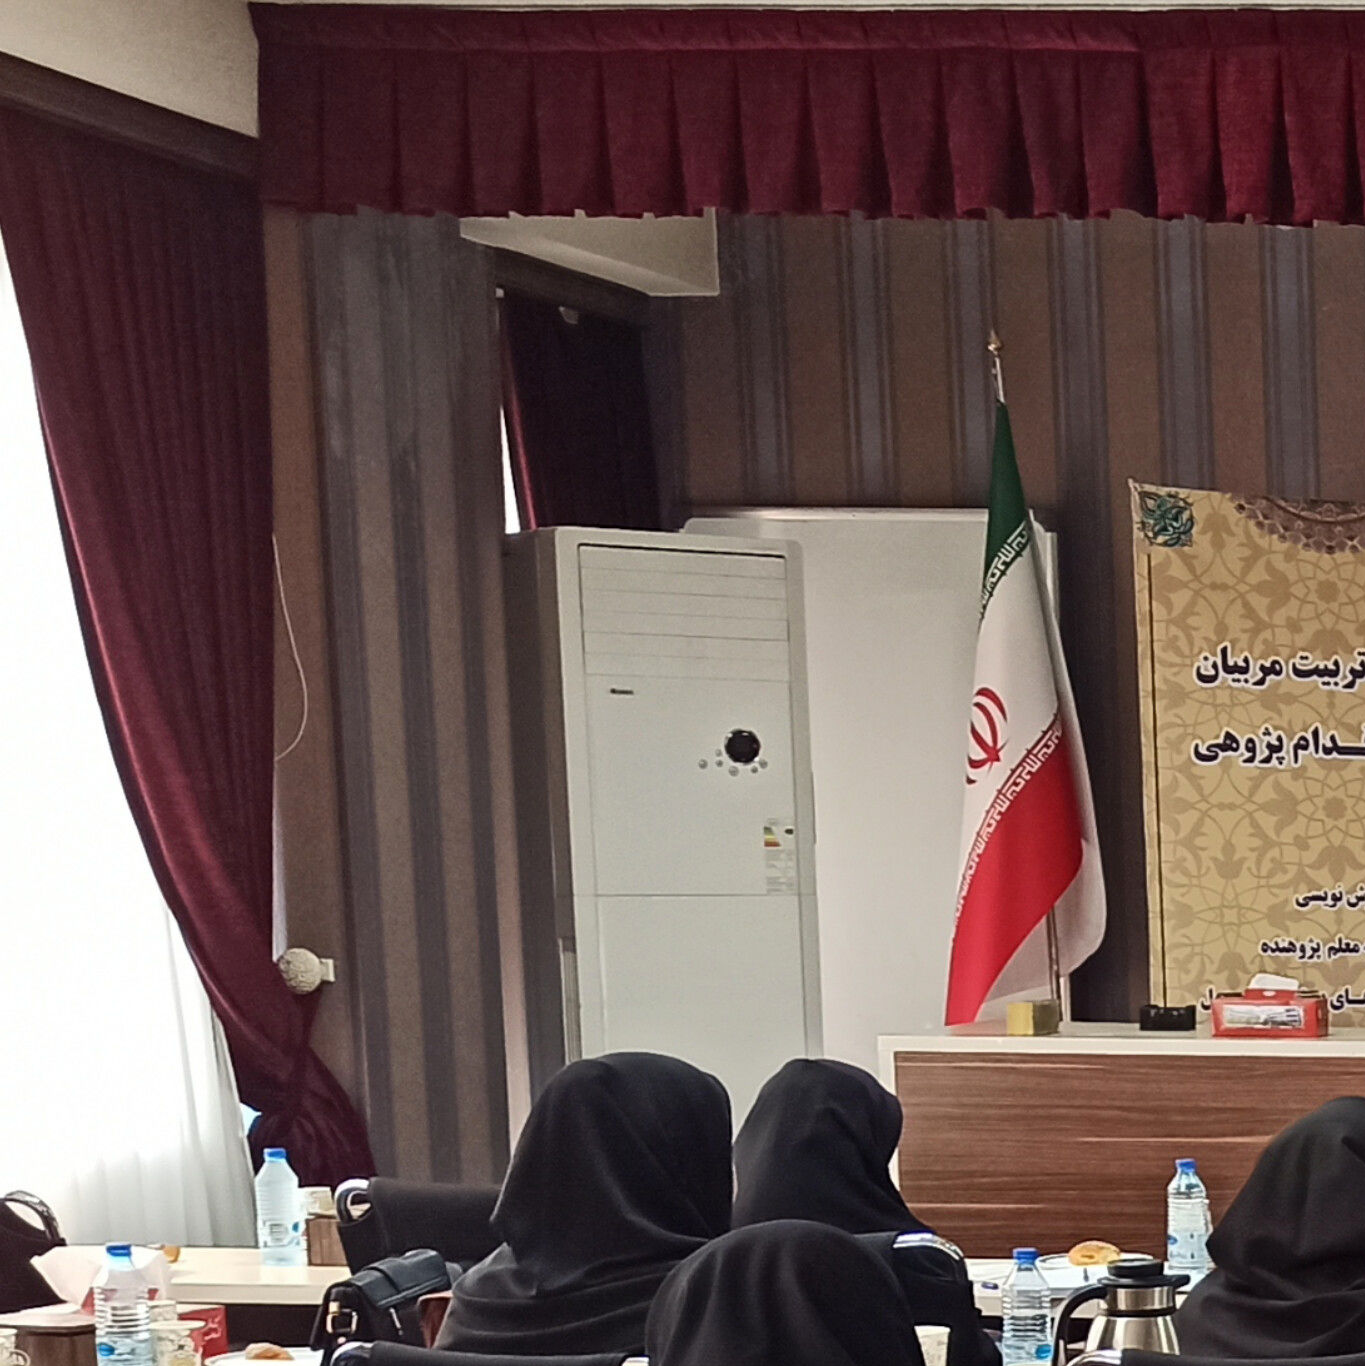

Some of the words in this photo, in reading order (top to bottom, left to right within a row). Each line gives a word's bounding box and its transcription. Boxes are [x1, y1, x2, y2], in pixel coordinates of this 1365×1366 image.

[1195, 644, 1284, 687] مربیان
[1193, 725, 1284, 766] پژوهی
[1295, 884, 1343, 908] نویسی
[1260, 938, 1322, 961] پژوهنده
[1327, 936, 1361, 959] معلم
